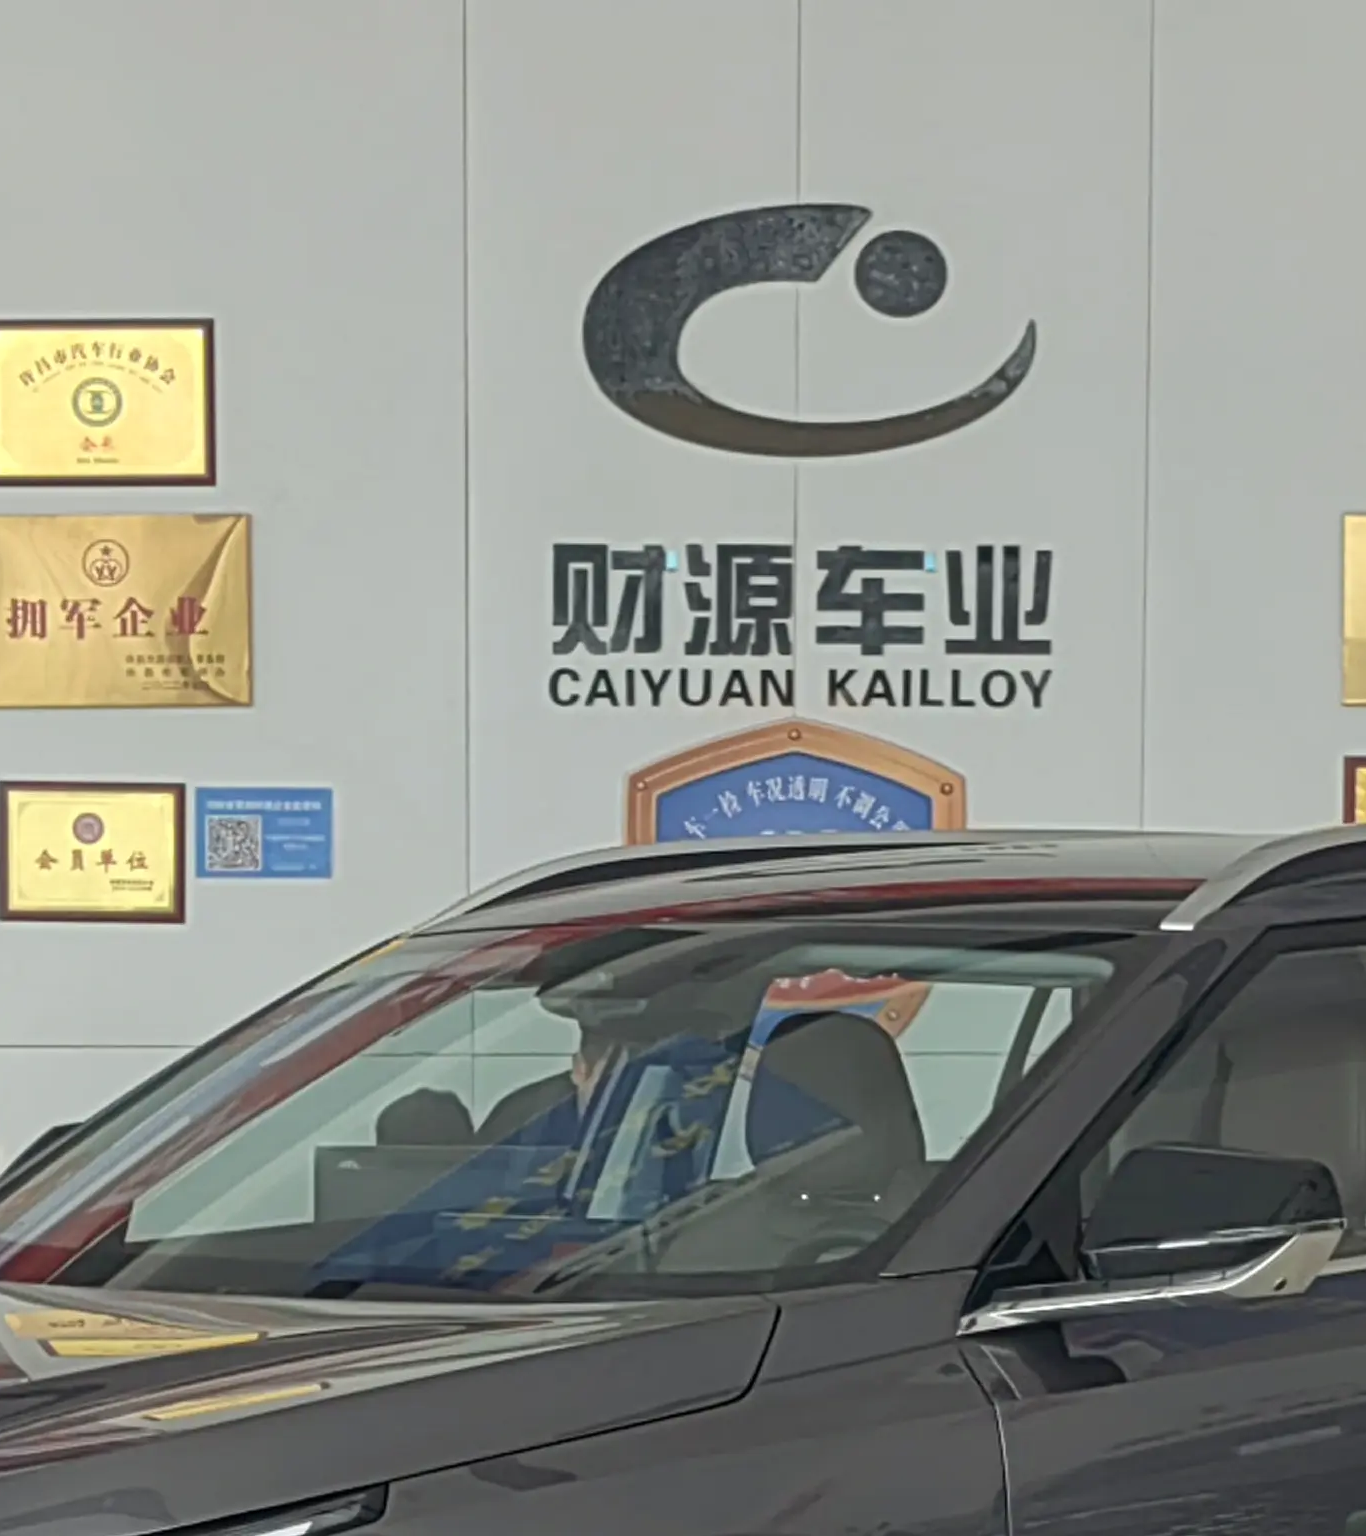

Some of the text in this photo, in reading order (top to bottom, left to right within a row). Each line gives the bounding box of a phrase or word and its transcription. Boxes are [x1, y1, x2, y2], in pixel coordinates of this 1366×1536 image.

[6, 596, 210, 640] 拥军企业
[552, 543, 1053, 656] 财源车业
[549, 668, 1053, 708] CAIYUAN KAILLOY
